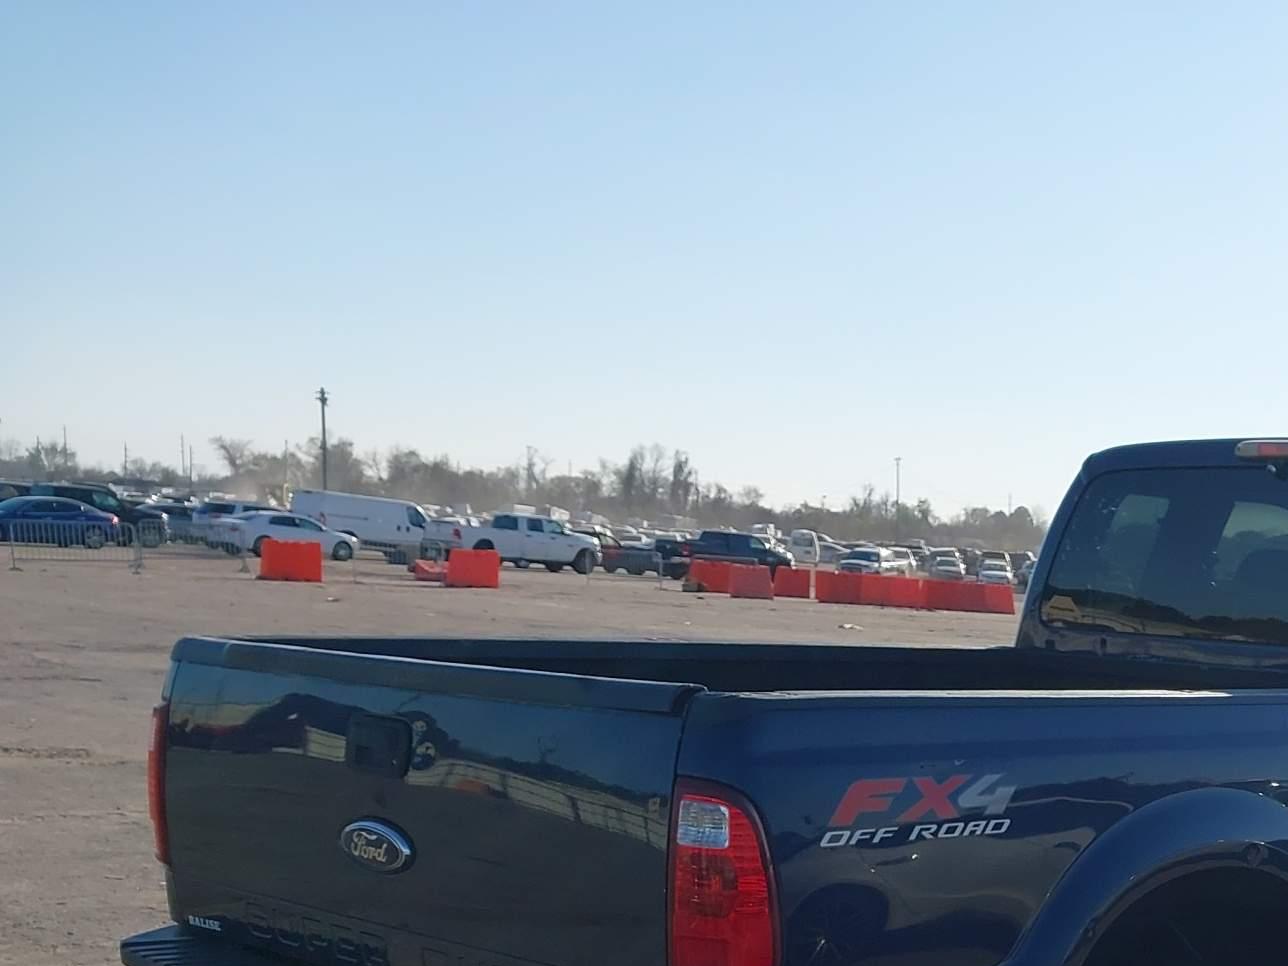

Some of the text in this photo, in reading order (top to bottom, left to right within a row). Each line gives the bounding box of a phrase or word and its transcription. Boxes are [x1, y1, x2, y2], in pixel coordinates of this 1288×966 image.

[828, 773, 1018, 828] FX4
[351, 831, 388, 863] Ford
[820, 818, 1012, 848] OFF ROAD
